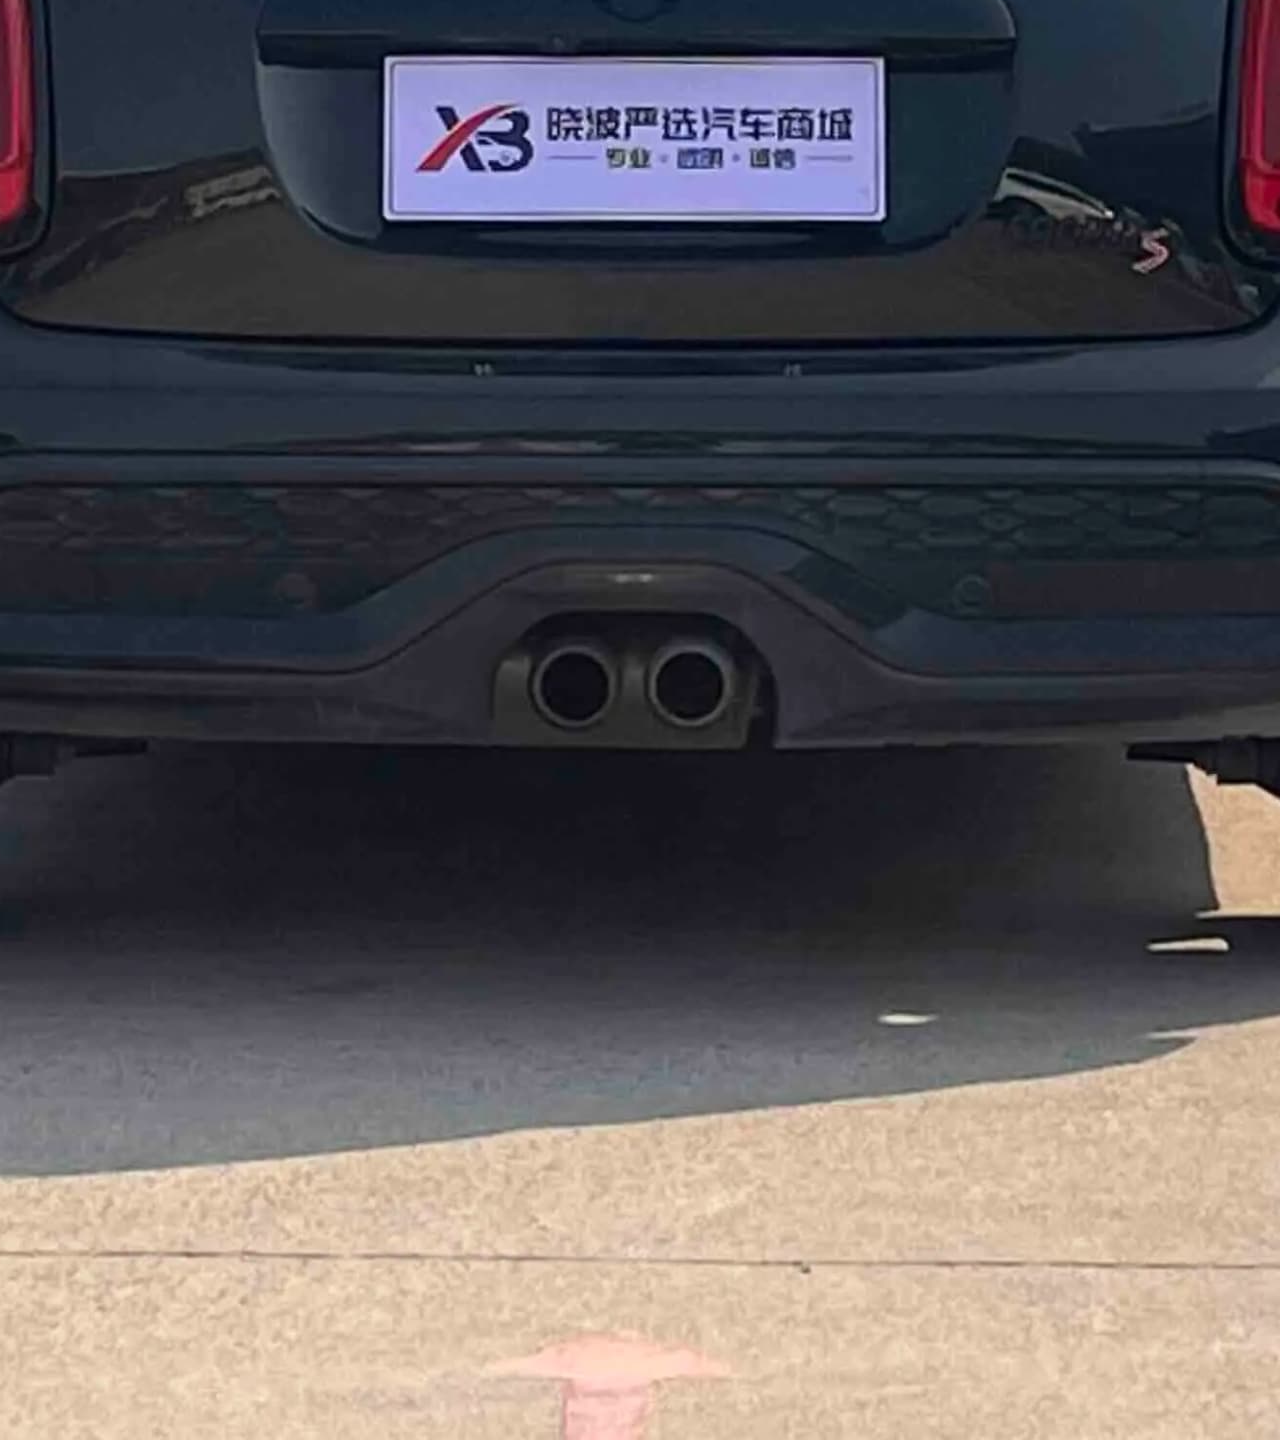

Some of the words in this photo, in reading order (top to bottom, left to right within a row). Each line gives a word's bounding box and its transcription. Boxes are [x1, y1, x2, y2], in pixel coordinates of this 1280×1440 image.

[546, 107, 853, 141] 晓波严选汽车商城
[1132, 227, 1169, 274] S
